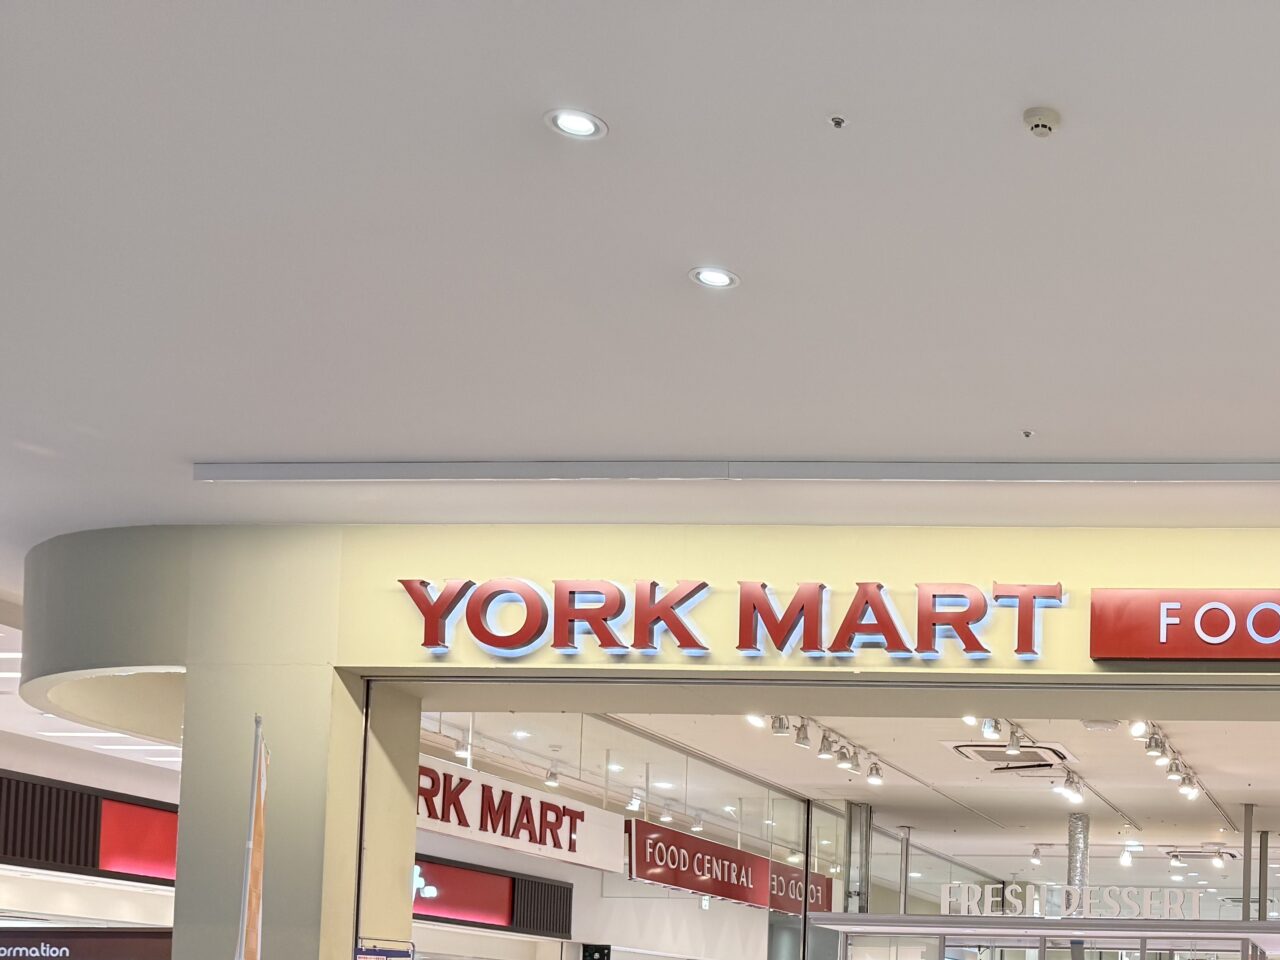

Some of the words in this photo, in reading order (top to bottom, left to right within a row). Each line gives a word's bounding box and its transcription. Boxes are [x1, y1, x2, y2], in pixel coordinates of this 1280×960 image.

[397, 578, 711, 655] YORK
[735, 579, 1064, 658] MART
[417, 765, 472, 828] RK
[479, 783, 584, 853] MART
[645, 839, 690, 872] FOOD
[692, 852, 754, 889] CENTRAL
[940, 883, 1047, 916] FRESH
[1061, 885, 1201, 919] DESSERT
